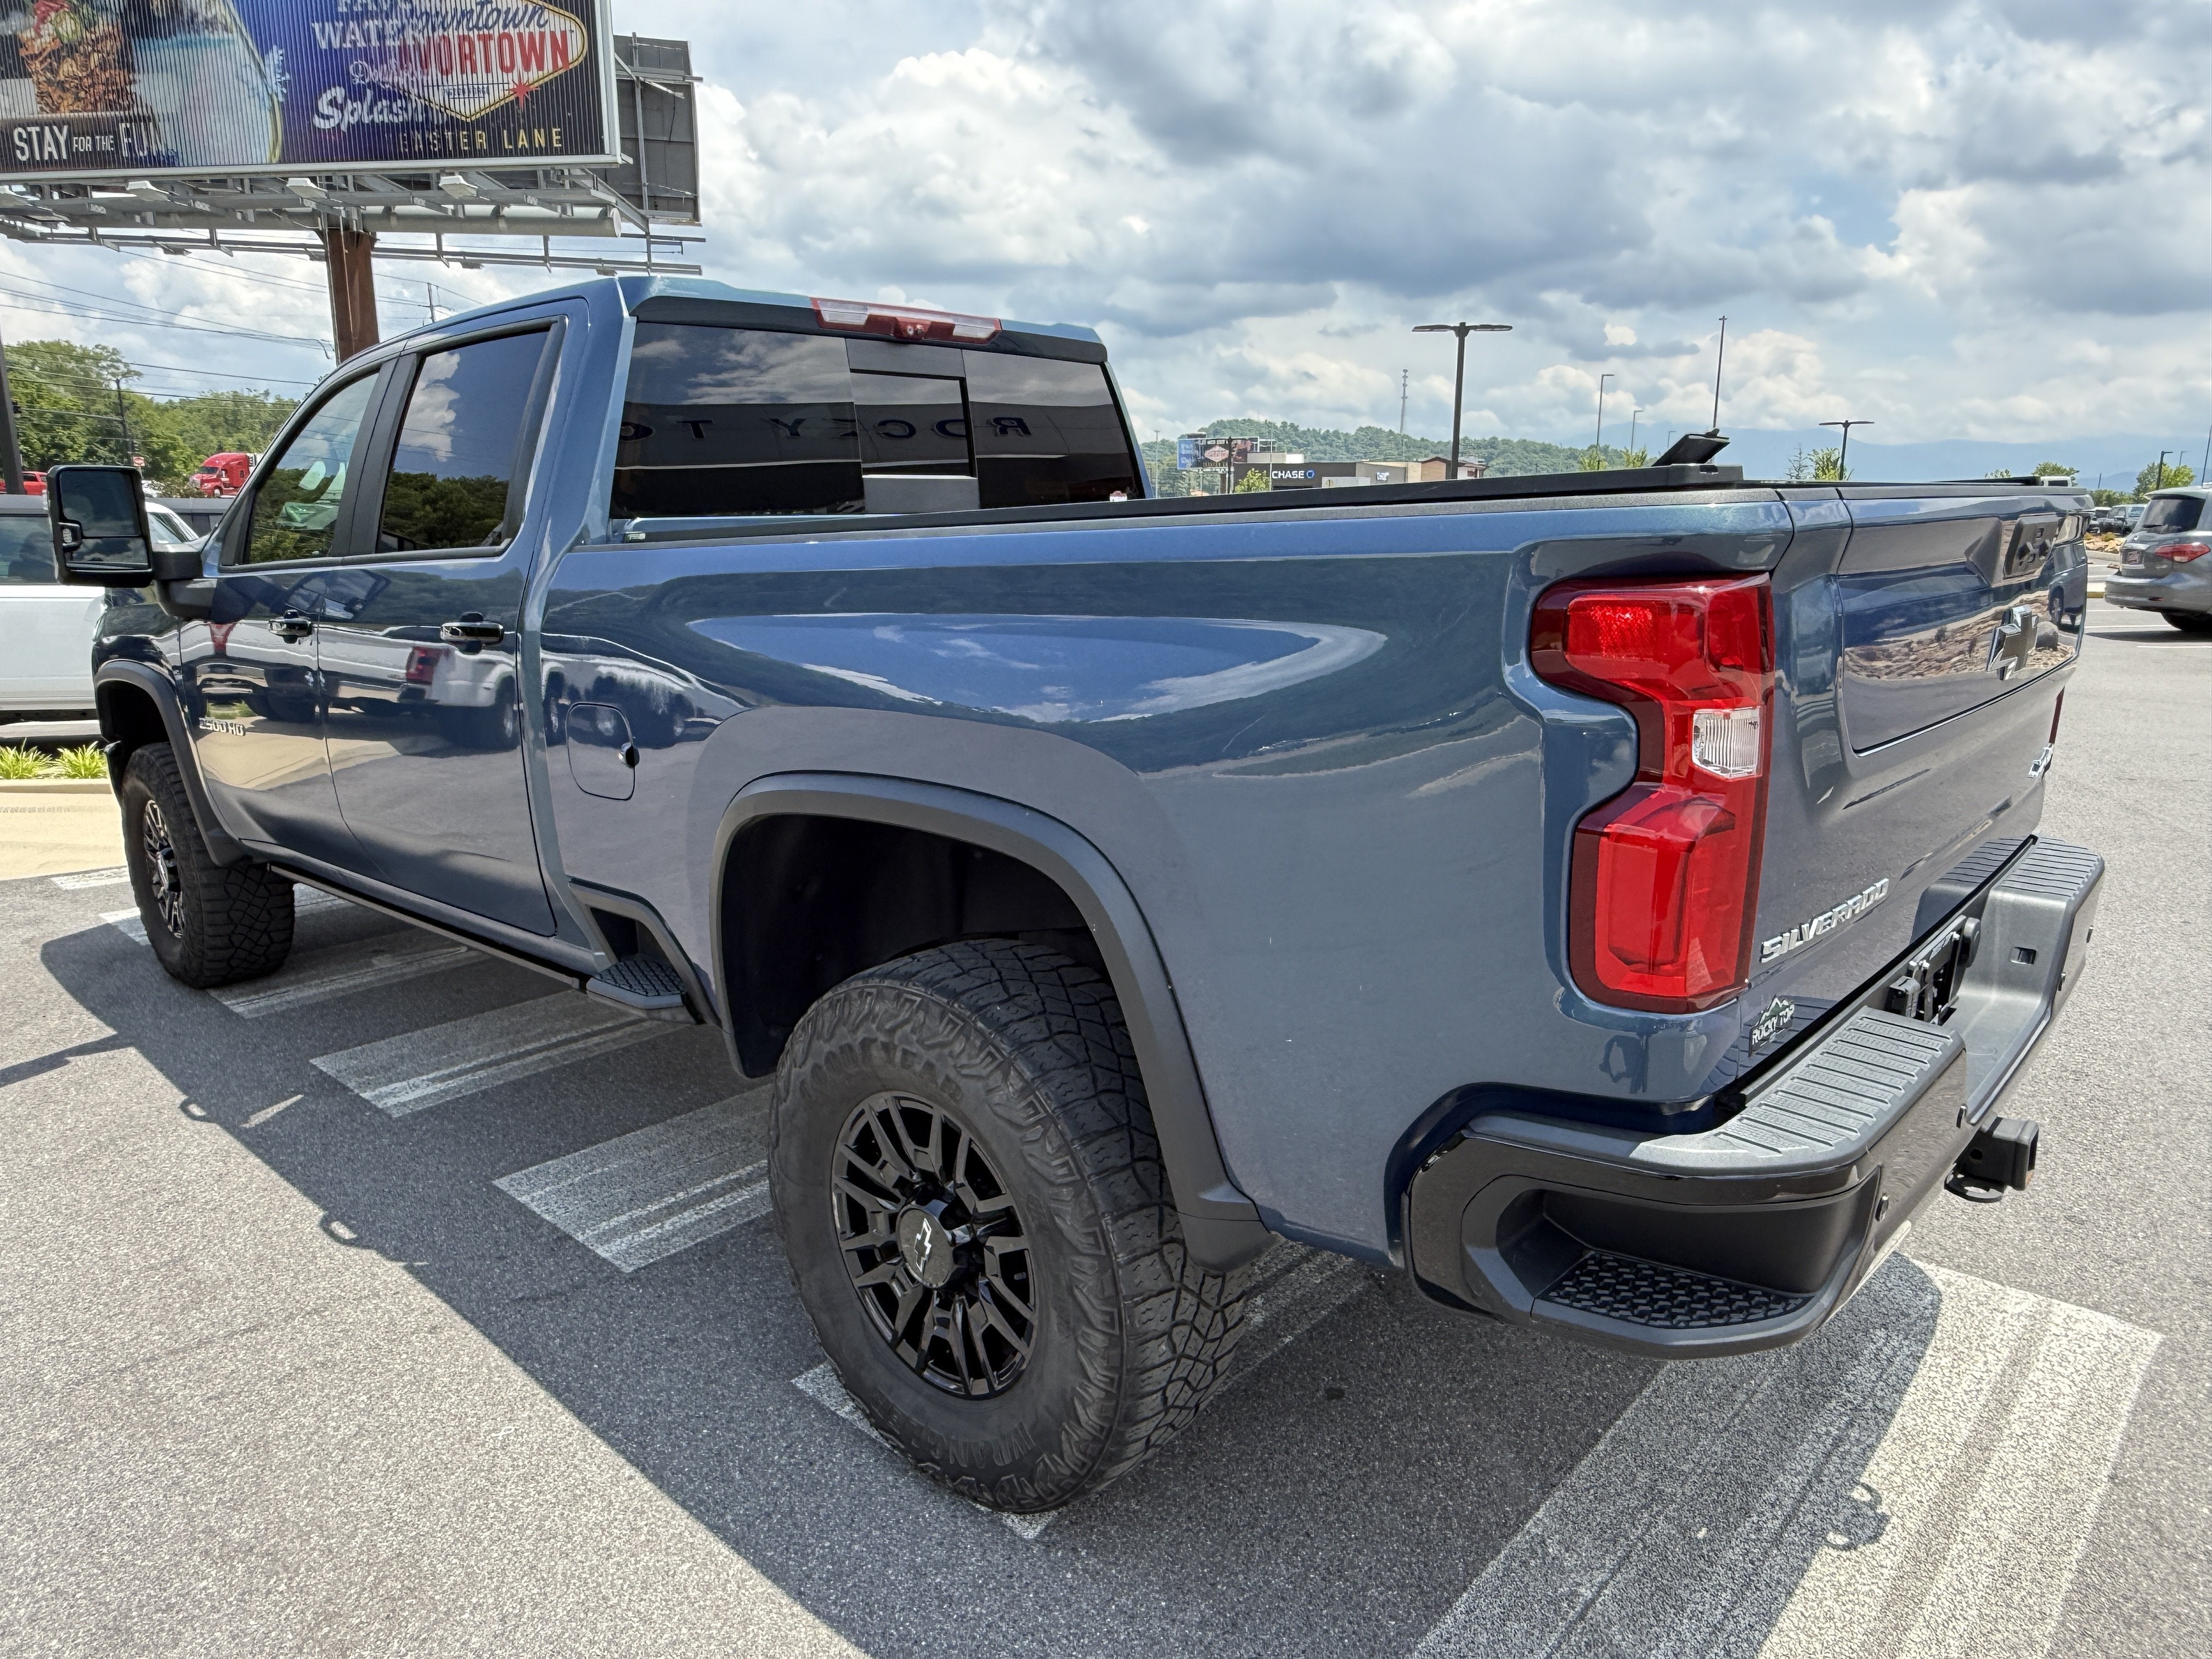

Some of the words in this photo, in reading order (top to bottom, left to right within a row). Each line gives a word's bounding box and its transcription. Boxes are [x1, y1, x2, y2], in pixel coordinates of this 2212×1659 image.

[13, 124, 69, 162] STAY
[73, 137, 92, 153] FOR
[503, 128, 562, 149] LANE
[1272, 470, 1305, 479] CHASE
[1759, 878, 1889, 963] SILVERADO
